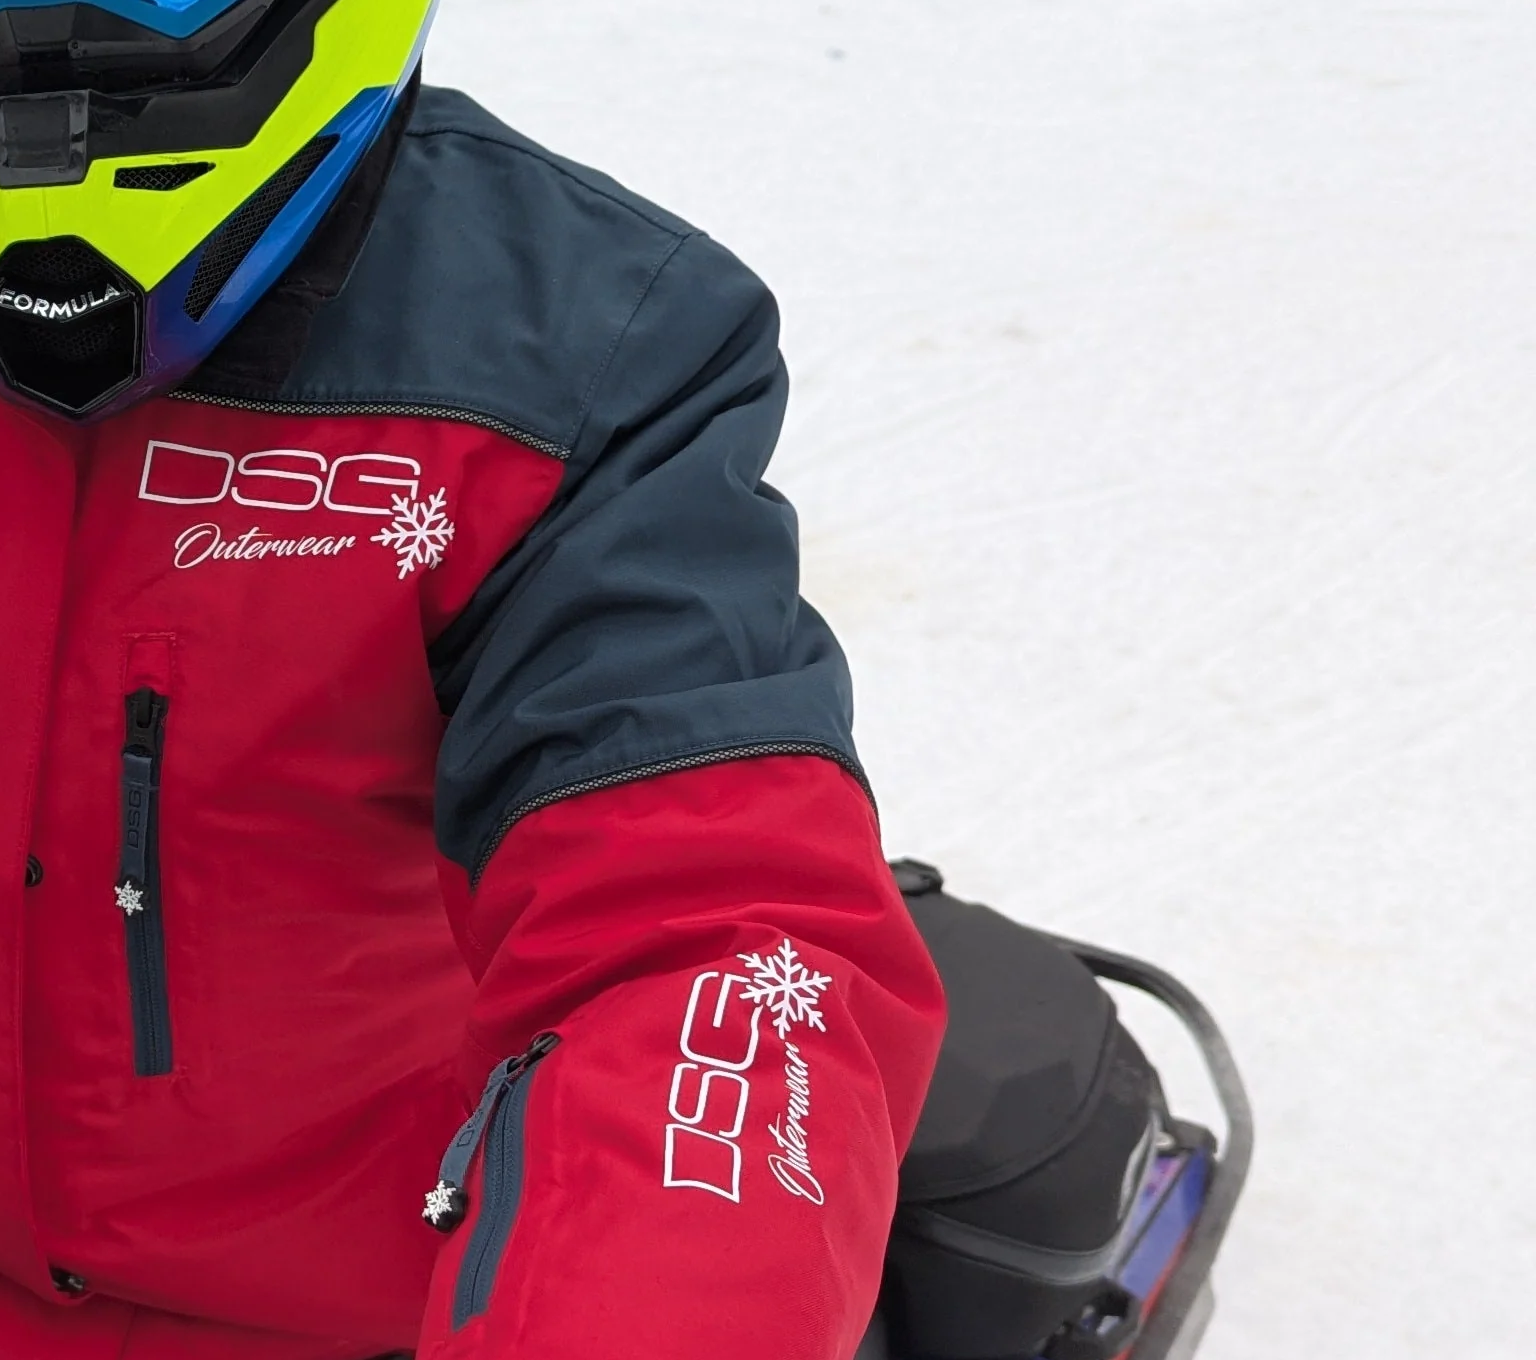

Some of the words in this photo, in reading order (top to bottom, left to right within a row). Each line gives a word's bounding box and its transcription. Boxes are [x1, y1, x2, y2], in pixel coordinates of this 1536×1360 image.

[138, 439, 421, 514] DSG
[173, 523, 356, 569] Outerwear
[663, 971, 764, 1204] DSG
[767, 1041, 825, 1205] Outerwear
